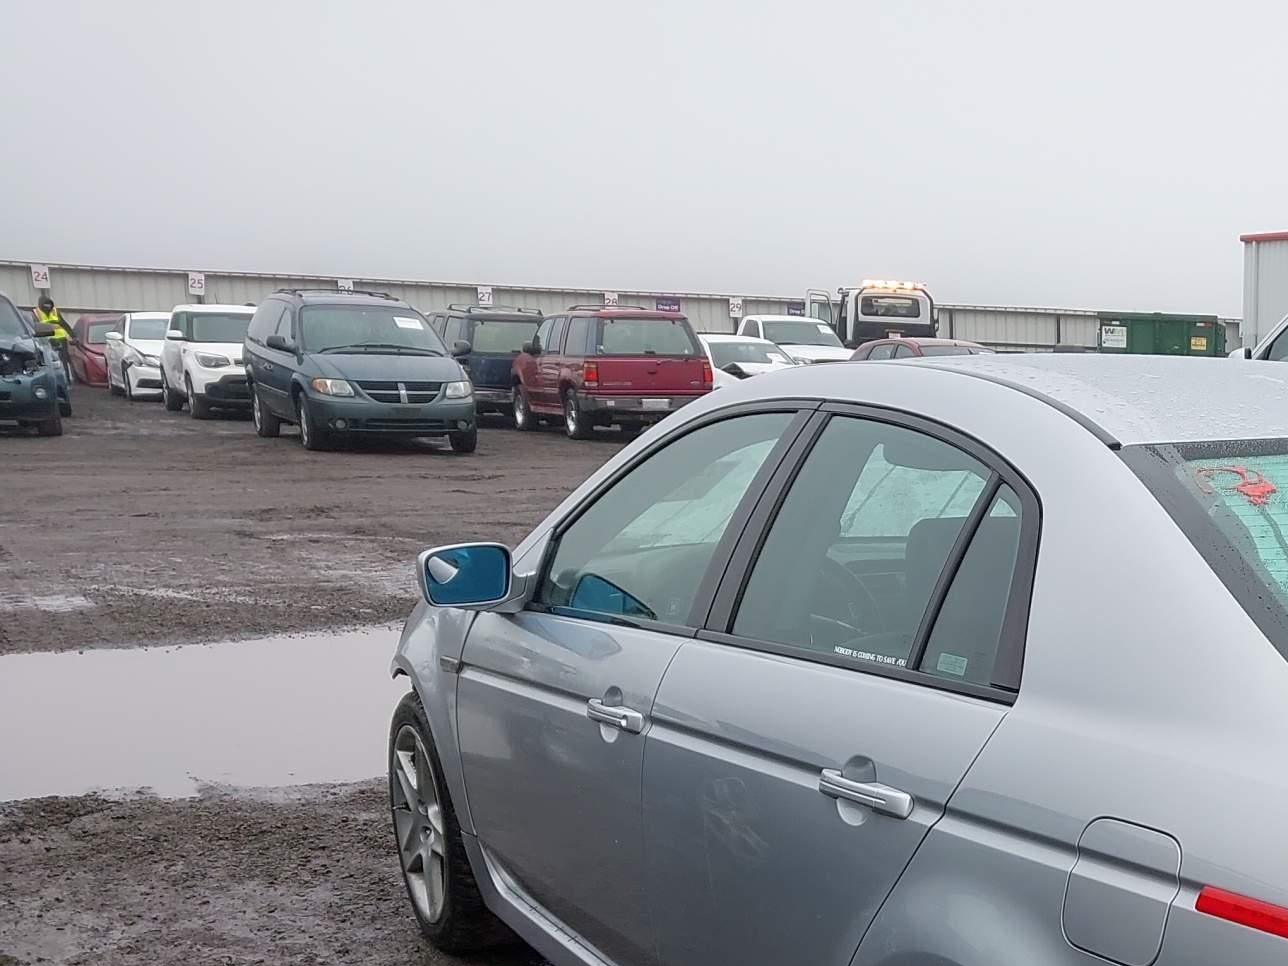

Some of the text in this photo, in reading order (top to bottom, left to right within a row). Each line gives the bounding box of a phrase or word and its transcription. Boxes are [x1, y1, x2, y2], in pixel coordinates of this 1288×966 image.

[34, 271, 48, 282] 24
[190, 278, 203, 289] 25
[479, 292, 492, 302] 27
[730, 302, 742, 313] 29
